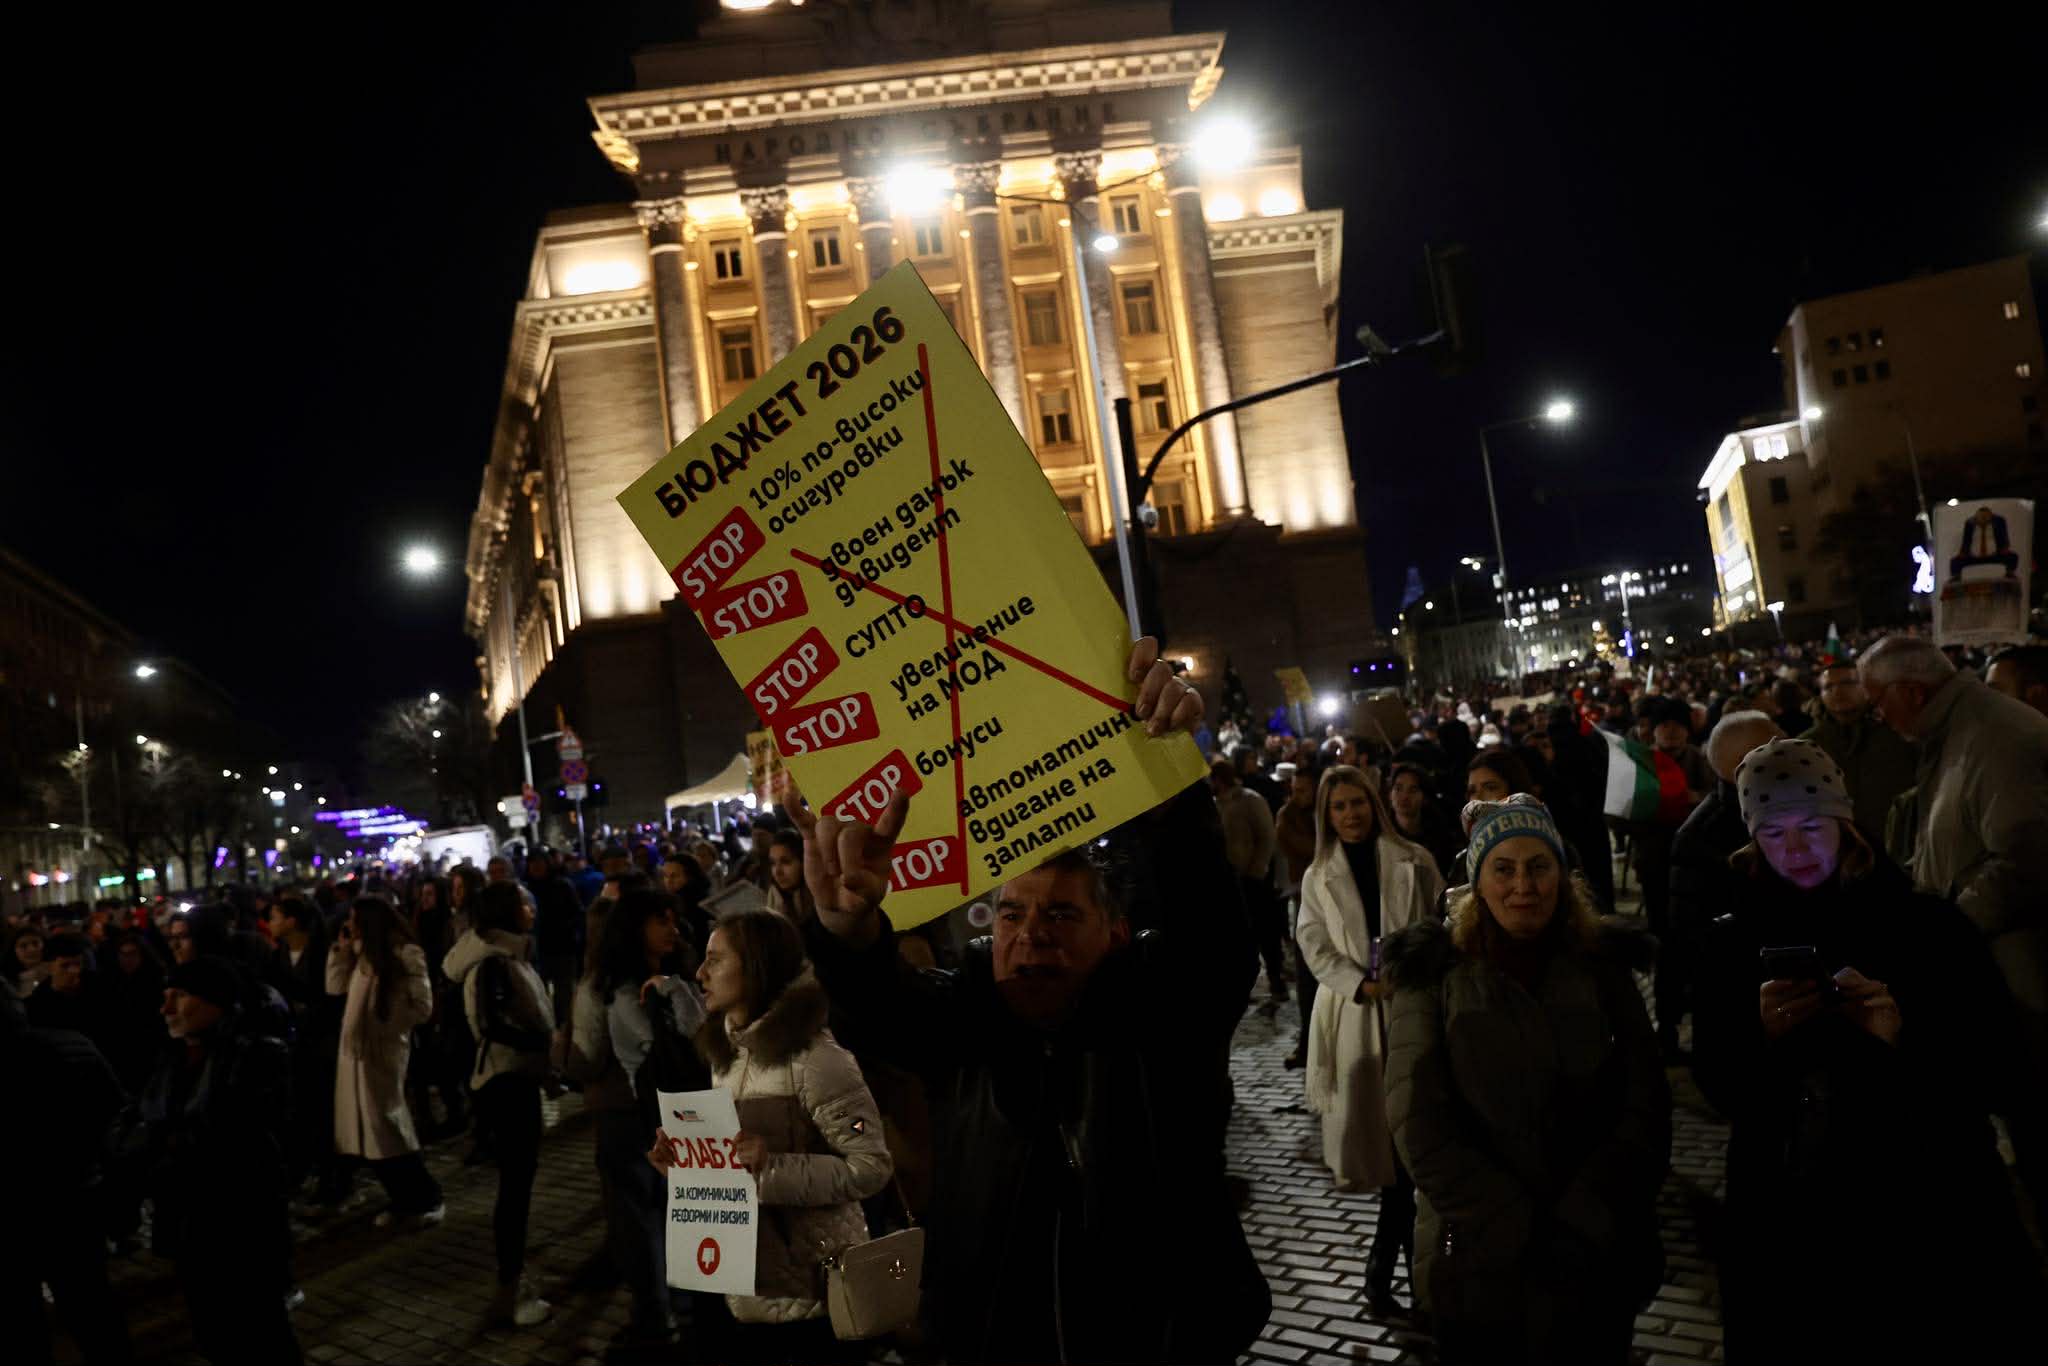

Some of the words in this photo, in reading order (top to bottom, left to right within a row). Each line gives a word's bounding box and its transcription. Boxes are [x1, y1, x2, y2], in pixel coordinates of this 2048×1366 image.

[655, 381, 808, 518] БЮДЖЕТ
[806, 306, 905, 399] 2026
[749, 461, 801, 510] 10%
[801, 369, 926, 472] по-високи
[769, 426, 903, 534] осигуровки
[820, 516, 894, 582] двоен
[896, 459, 974, 528] данък
[682, 522, 745, 598] STOP
[835, 507, 960, 607] дивидент
[713, 575, 789, 637] STOP
[845, 595, 926, 658] СУПТО
[755, 642, 818, 714] STOP
[891, 596, 1035, 700] увеличение
[906, 693, 939, 721] на
[938, 650, 1006, 700] МОД
[785, 697, 861, 755] STOP
[915, 715, 1003, 775] бонуси
[968, 778, 1077, 843] вдигане
[1079, 758, 1116, 787] на
[886, 840, 949, 892] TOP
[984, 803, 1096, 877] заплати
[671, 1137, 726, 1169] СЛАБ
[671, 1208, 712, 1224] РЕФОРМИ
[713, 1209, 719, 1224] И
[720, 1210, 750, 1225] ВИЗИЯ!
[675, 1186, 684, 1200] ЗА
[686, 1187, 748, 1204] КОМУНИКАЦИЯ,
